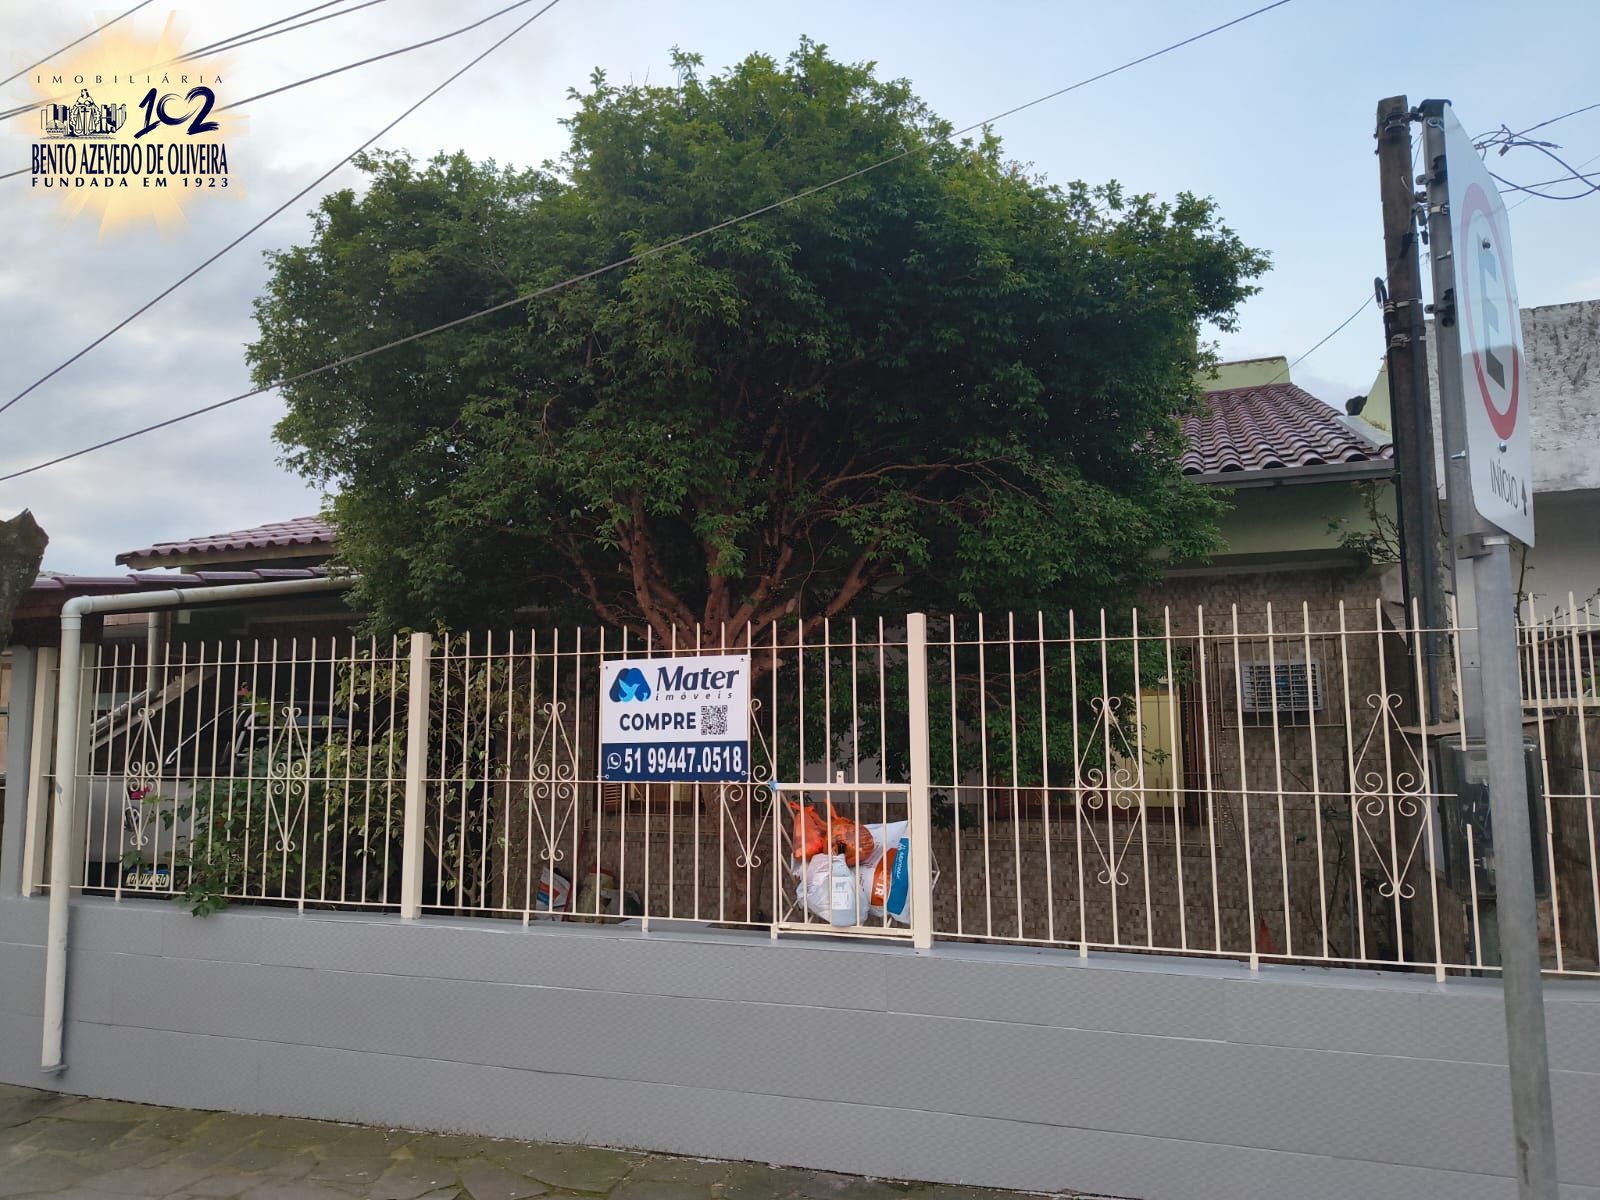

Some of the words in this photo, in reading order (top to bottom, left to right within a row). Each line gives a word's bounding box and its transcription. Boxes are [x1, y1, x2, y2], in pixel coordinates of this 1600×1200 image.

[1489, 457, 1518, 509] INÍCIO
[656, 665, 740, 692] Mater
[655, 691, 732, 701] imóveis
[619, 712, 697, 731] COMPRE
[624, 748, 642, 774] 51
[648, 746, 742, 774] 99447.0518
